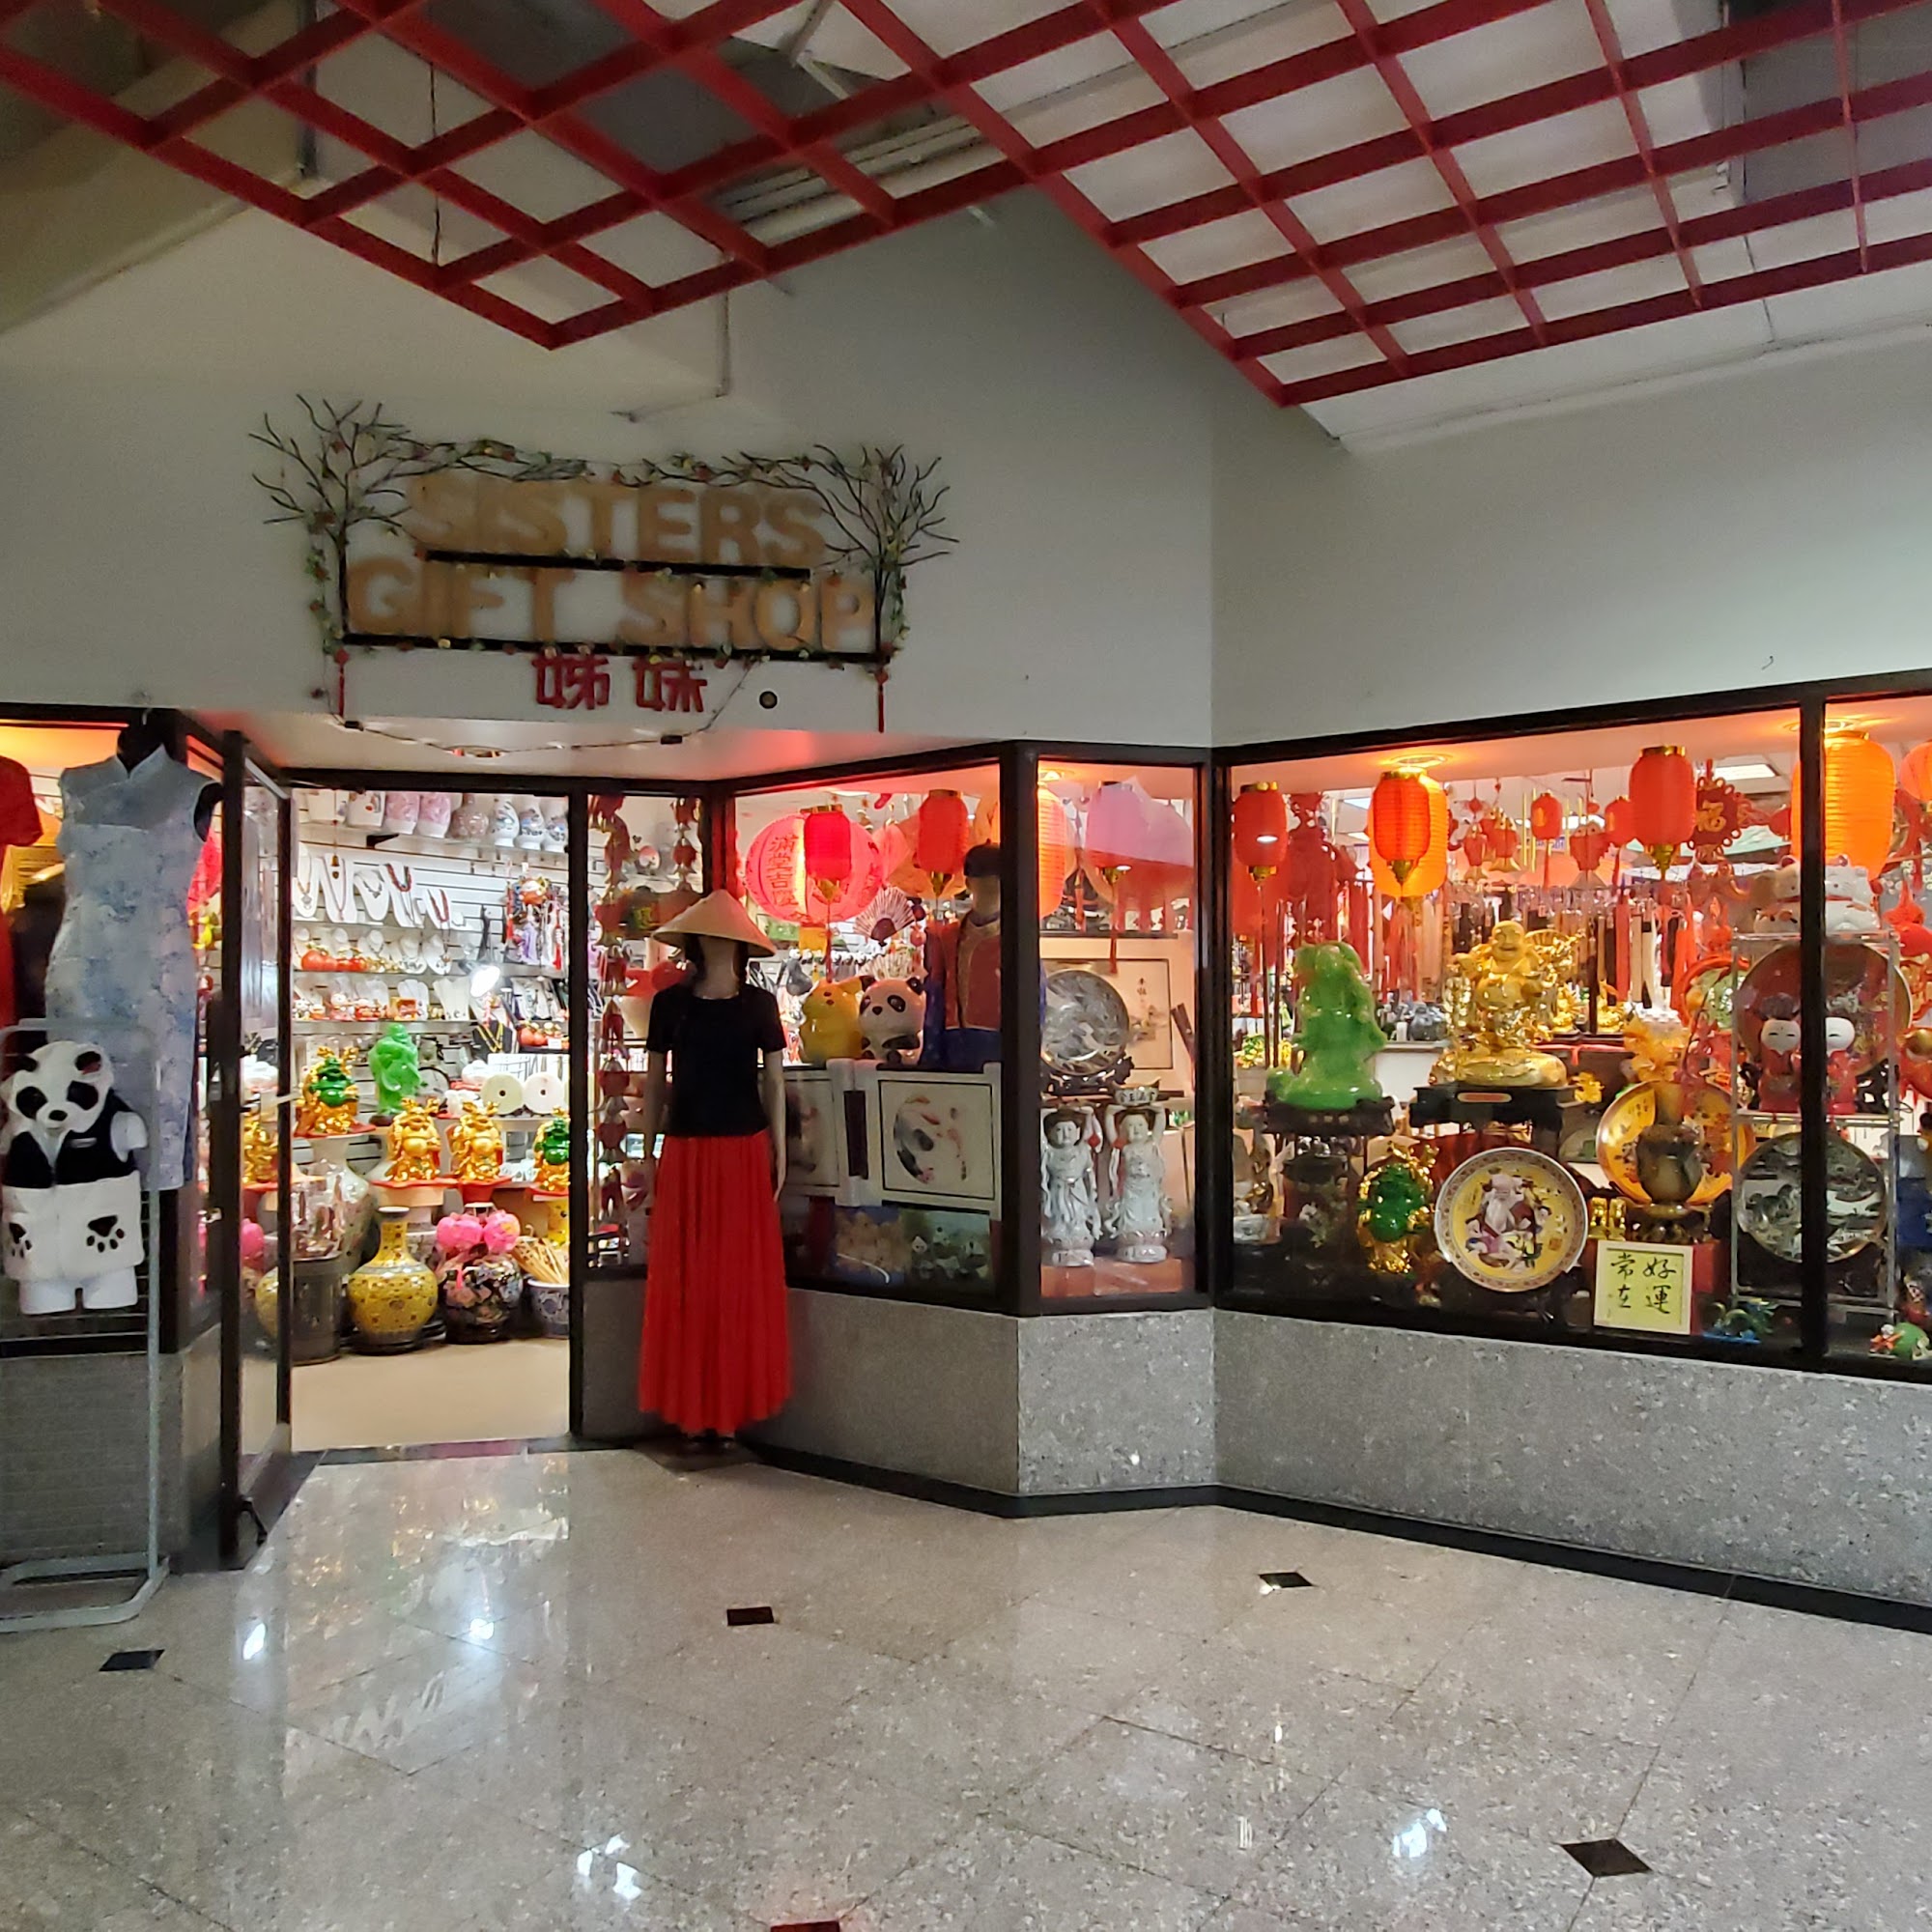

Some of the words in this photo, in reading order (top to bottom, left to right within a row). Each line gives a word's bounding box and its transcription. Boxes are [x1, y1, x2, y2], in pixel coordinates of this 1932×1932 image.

[405, 480, 826, 568] SISTERS
[347, 556, 576, 641] GIFT
[619, 567, 876, 653] SHOP
